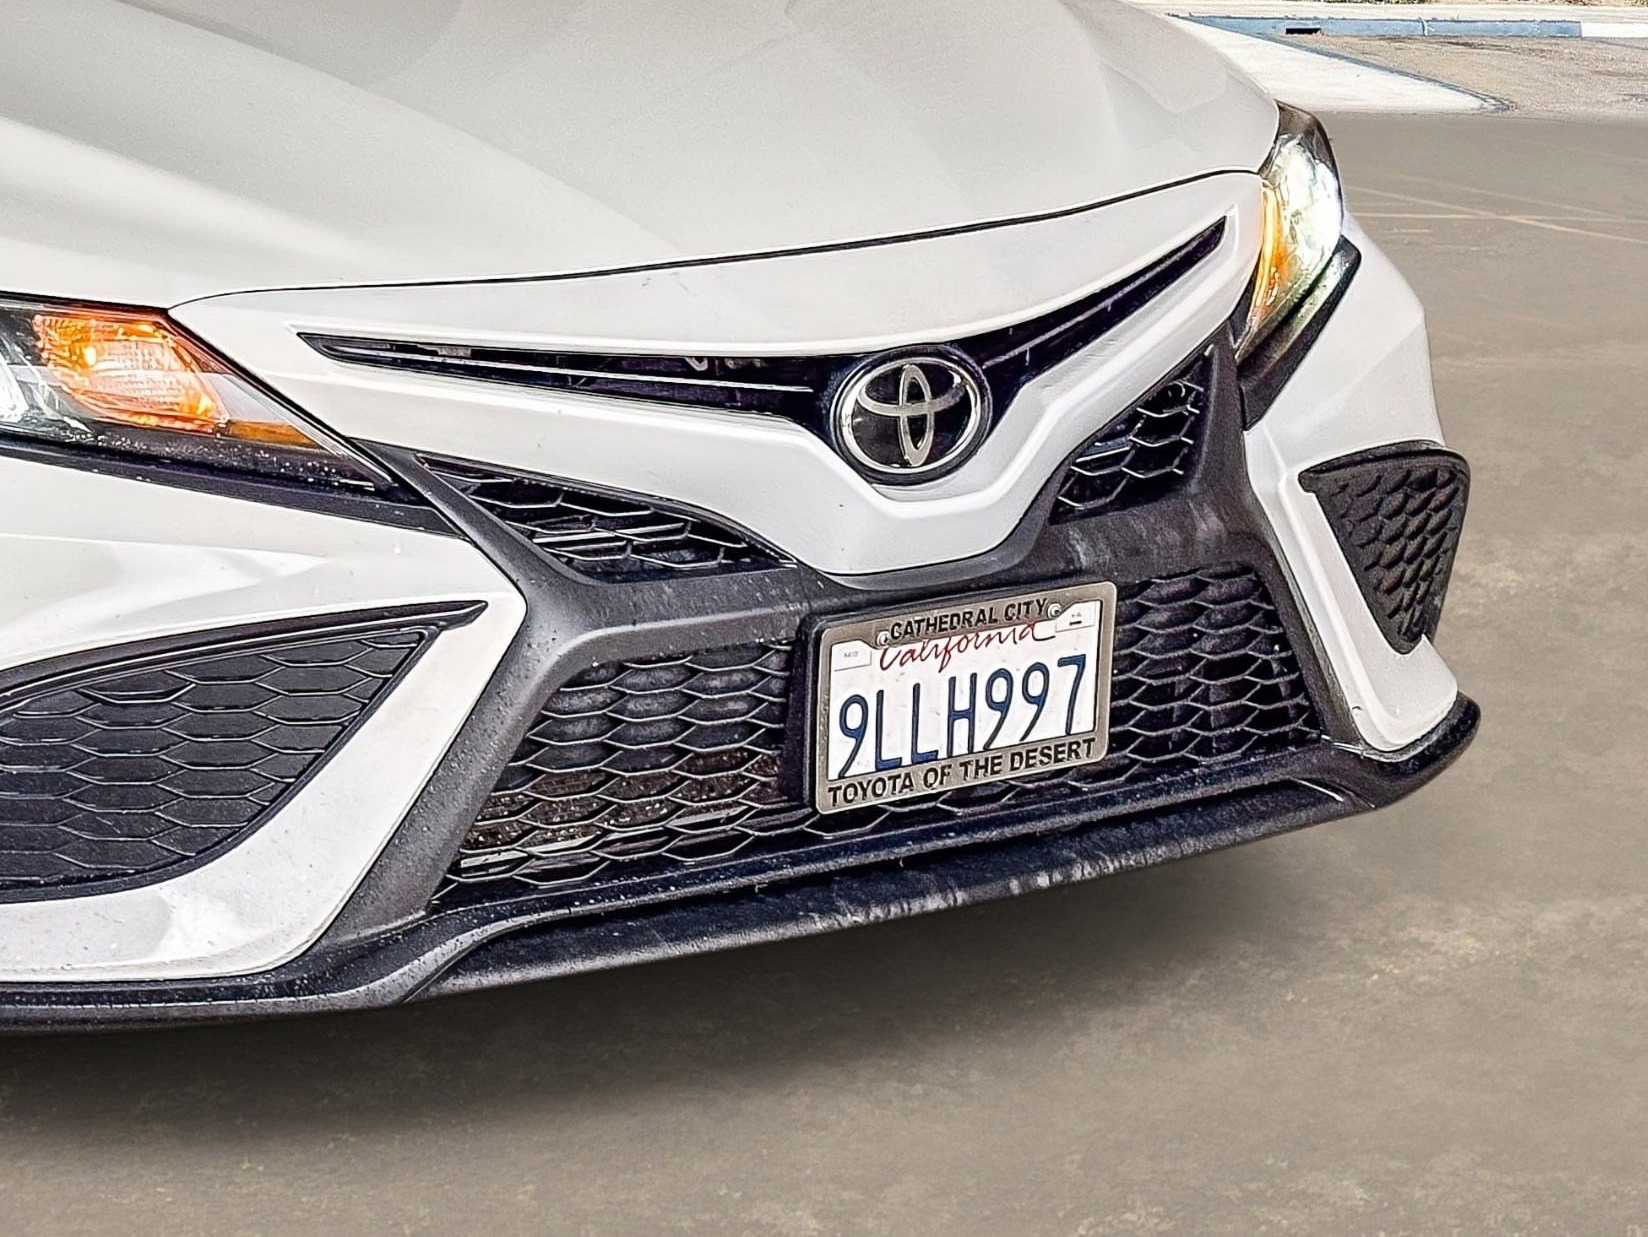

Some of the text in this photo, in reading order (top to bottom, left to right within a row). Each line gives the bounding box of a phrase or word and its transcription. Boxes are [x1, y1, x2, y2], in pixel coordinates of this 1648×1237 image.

[879, 620, 1056, 673] California
[890, 605, 999, 640] CATHEDRAL
[1004, 598, 1048, 622] CITY
[838, 654, 1087, 779] 9LLH997
[828, 737, 1096, 807] TOYOTA OF THE DESERT
